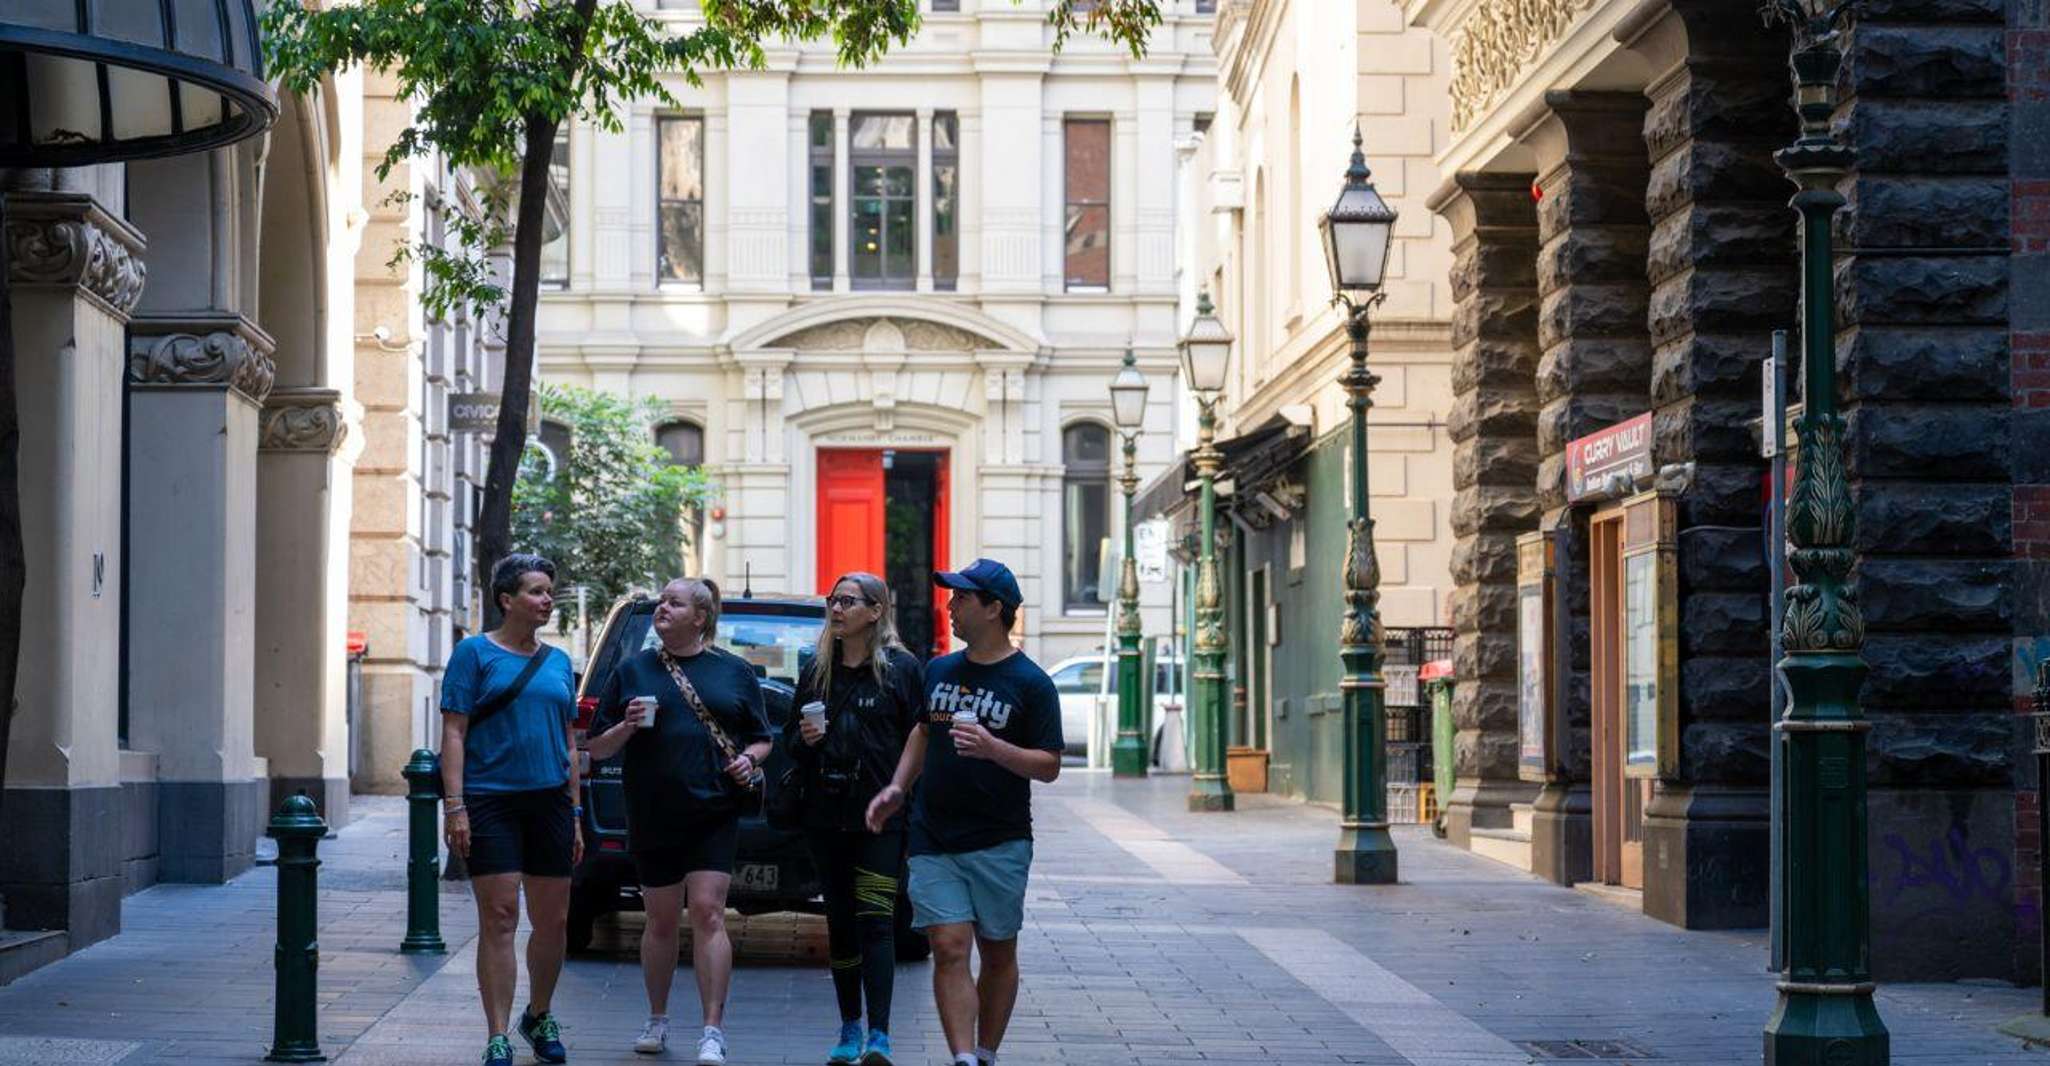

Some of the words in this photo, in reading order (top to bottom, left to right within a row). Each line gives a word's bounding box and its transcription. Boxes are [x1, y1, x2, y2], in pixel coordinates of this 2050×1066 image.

[1584, 434, 1616, 465] CURRY
[1616, 423, 1646, 453] VAULT
[929, 711, 952, 723] tour
[930, 681, 1013, 729] fitcity
